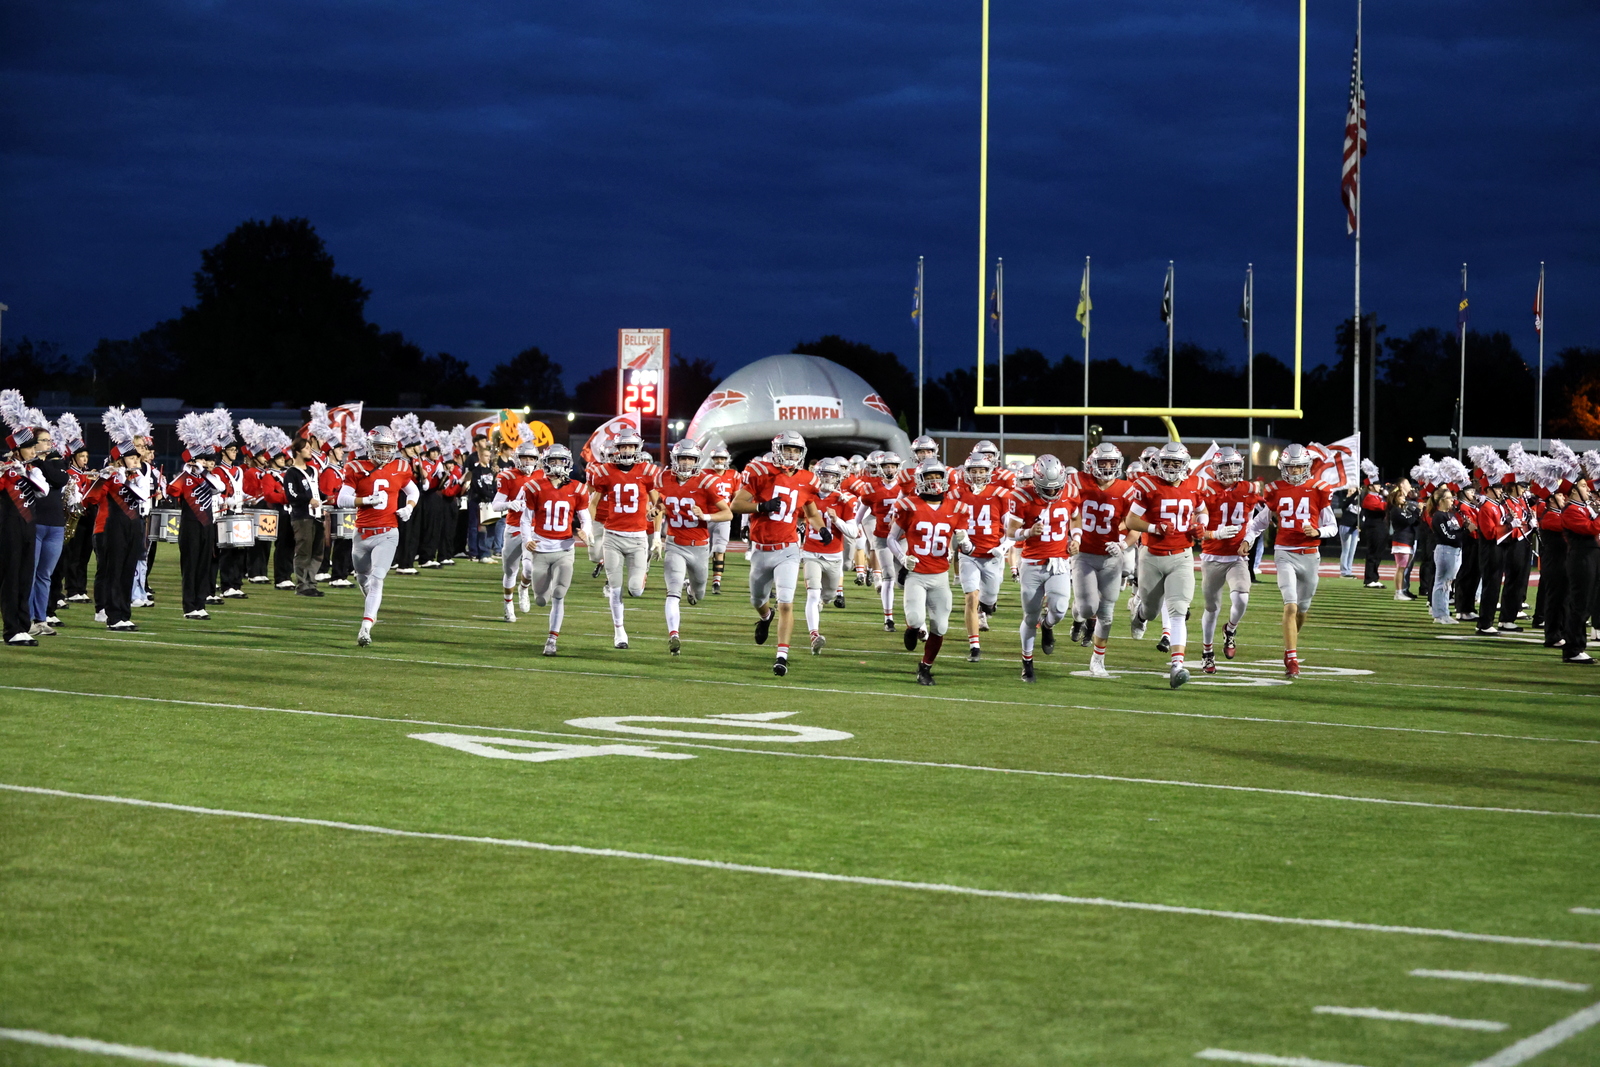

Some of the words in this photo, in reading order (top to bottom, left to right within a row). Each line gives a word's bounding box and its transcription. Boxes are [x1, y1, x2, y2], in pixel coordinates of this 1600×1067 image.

[624, 334, 661, 346] BELLEVUE
[624, 385, 656, 413] 25
[778, 406, 840, 420] REDMEN
[372, 478, 390, 510] 6
[613, 483, 639, 513] 13
[769, 485, 799, 524] 51
[543, 500, 570, 532] 10
[665, 496, 699, 528] 33
[1082, 500, 1115, 534] 63
[1160, 498, 1194, 532] 50
[1219, 501, 1245, 526] 14
[1280, 496, 1311, 528] 24
[913, 521, 951, 557] 36
